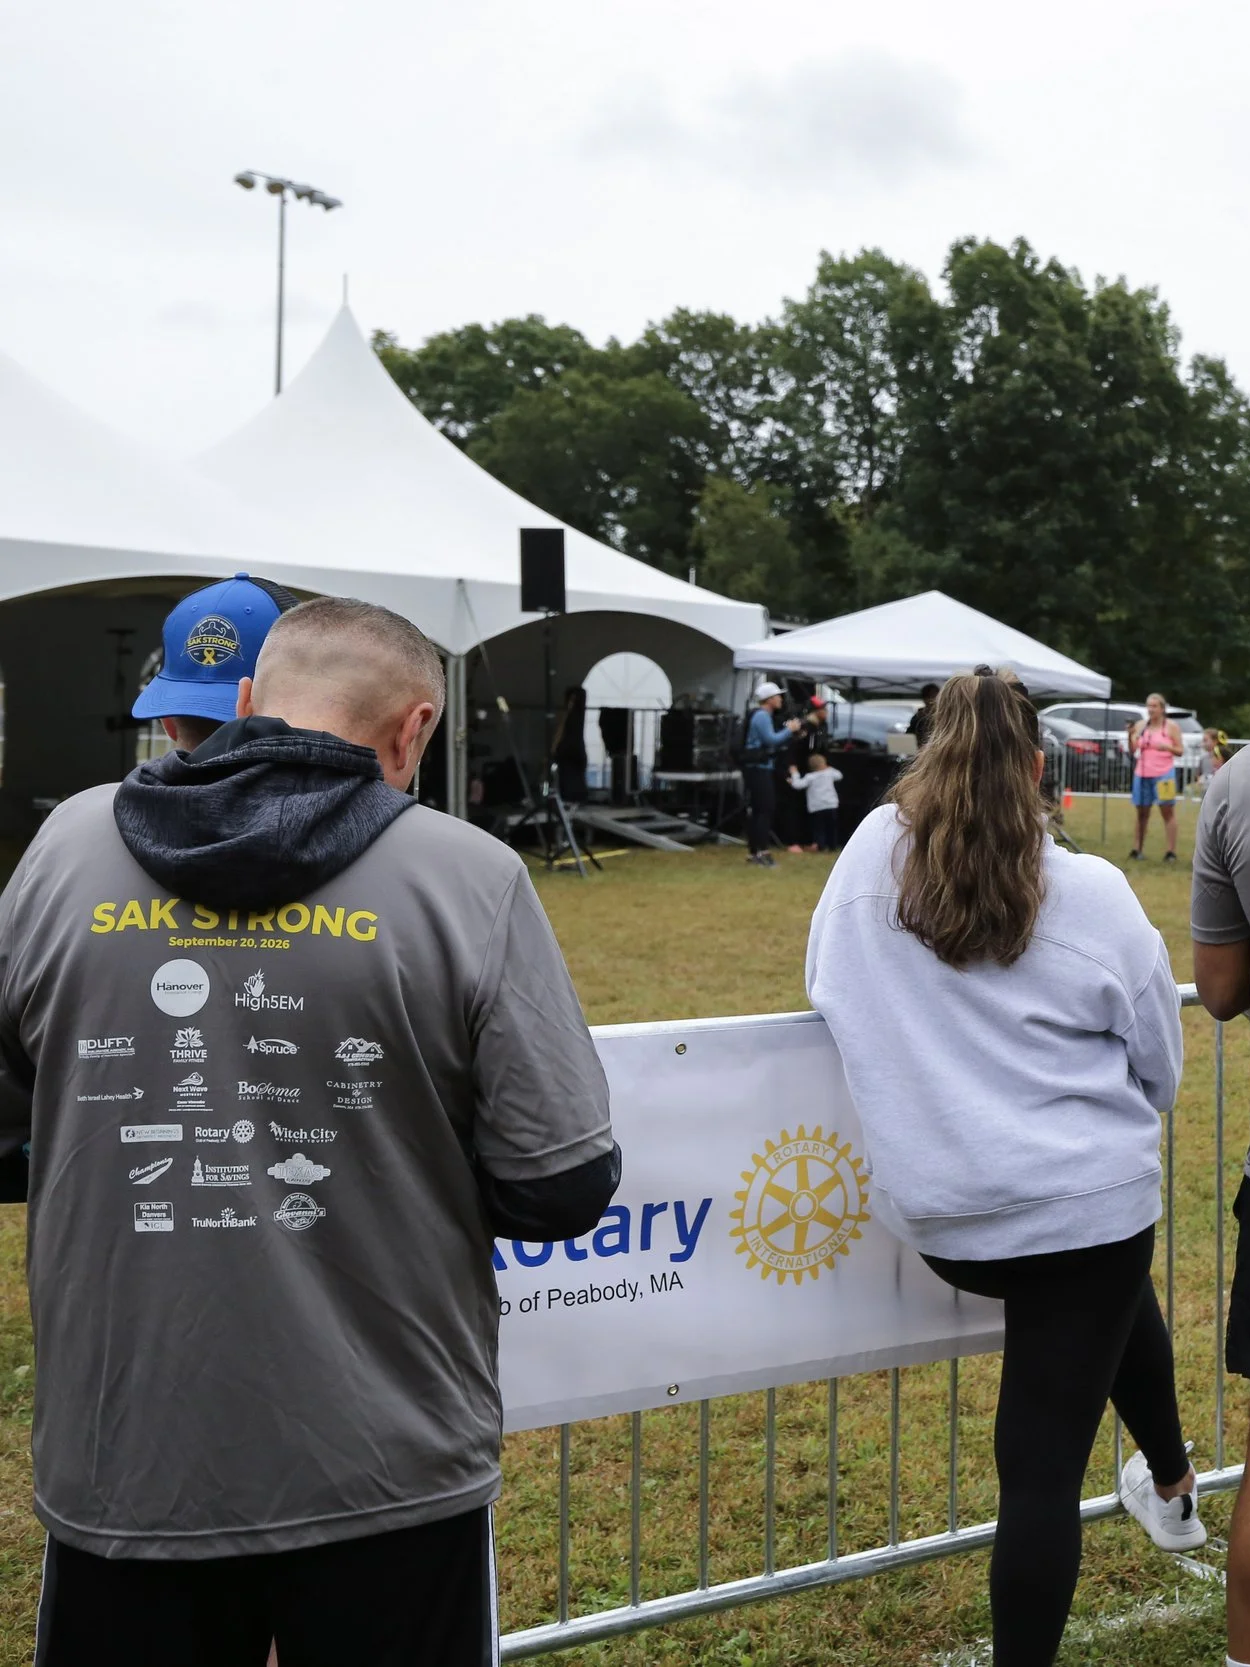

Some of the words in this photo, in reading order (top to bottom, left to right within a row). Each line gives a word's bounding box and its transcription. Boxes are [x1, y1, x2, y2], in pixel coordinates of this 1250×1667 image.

[187, 638, 201, 647] SAK
[202, 636, 237, 649] STRONG
[90, 898, 183, 933] SAK
[168, 936, 238, 949] September
[240, 937, 257, 949] 20,
[260, 938, 290, 949] 2026
[156, 982, 204, 991] Hanover
[235, 993, 304, 1011] High5EM
[88, 1036, 135, 1049] DUFFY
[259, 1042, 298, 1055] Spruce
[170, 1049, 208, 1059] THRIVE
[238, 1081, 301, 1097] BoSoma
[326, 1080, 383, 1090] CABINETRY
[337, 1096, 372, 1105] DESIGN
[195, 1126, 230, 1139] Rotary
[272, 1127, 308, 1140] Witch
[310, 1128, 338, 1141] City
[772, 1142, 831, 1164] ROTARY
[277, 1165, 322, 1178] TEXAS
[192, 1216, 257, 1228] TruNorthBank
[750, 1225, 852, 1269] INTERNATIONAL
[519, 1290, 541, 1313] of
[547, 1278, 643, 1310] Peabody,
[650, 1271, 684, 1293] MA
